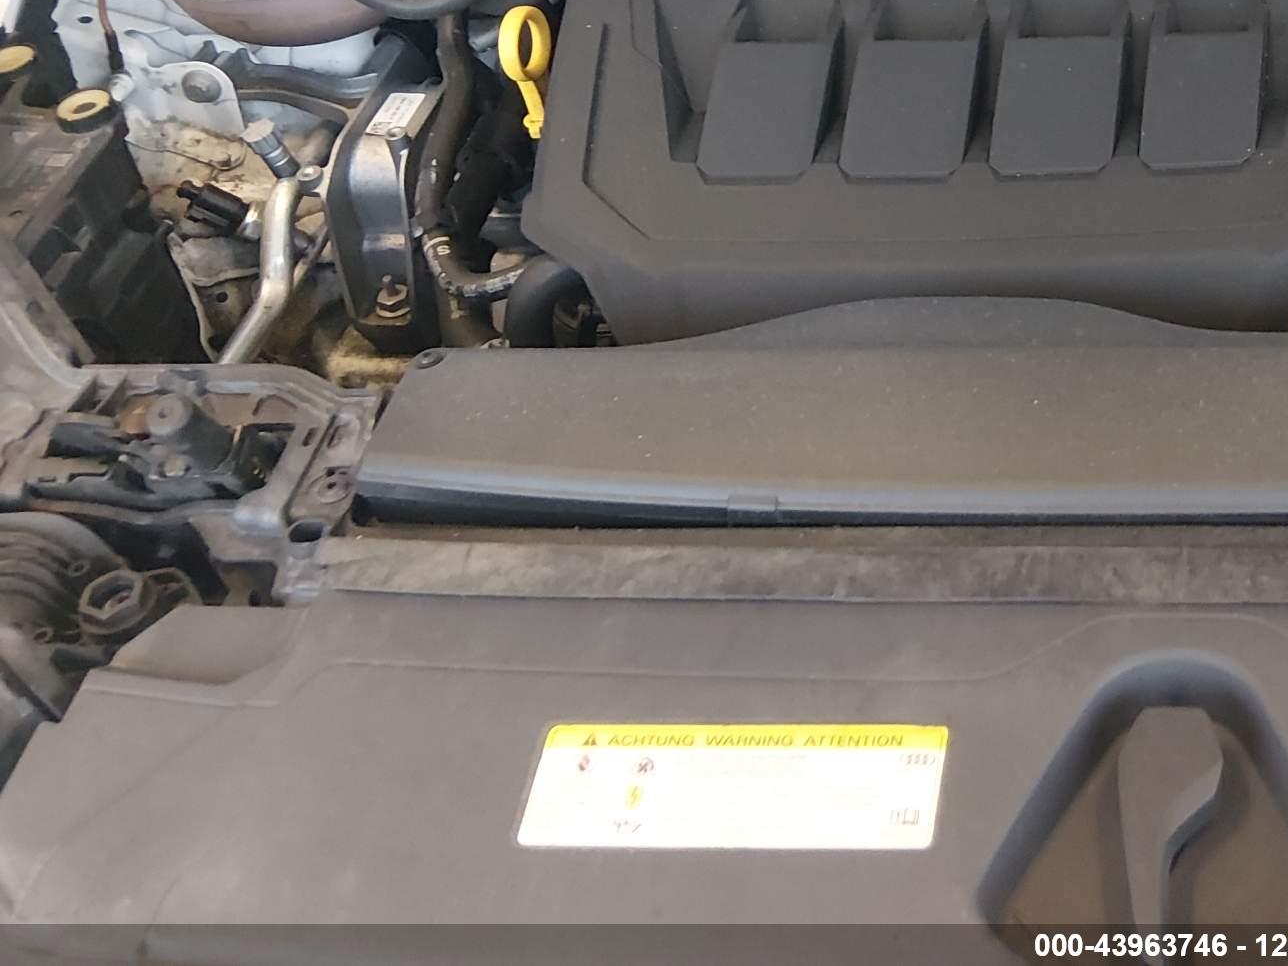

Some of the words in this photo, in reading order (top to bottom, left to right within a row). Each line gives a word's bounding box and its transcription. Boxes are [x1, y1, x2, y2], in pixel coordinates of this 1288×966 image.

[607, 733, 695, 747] ACHTUNG
[705, 733, 793, 747] WARNING
[803, 733, 904, 747] ATTENTION
